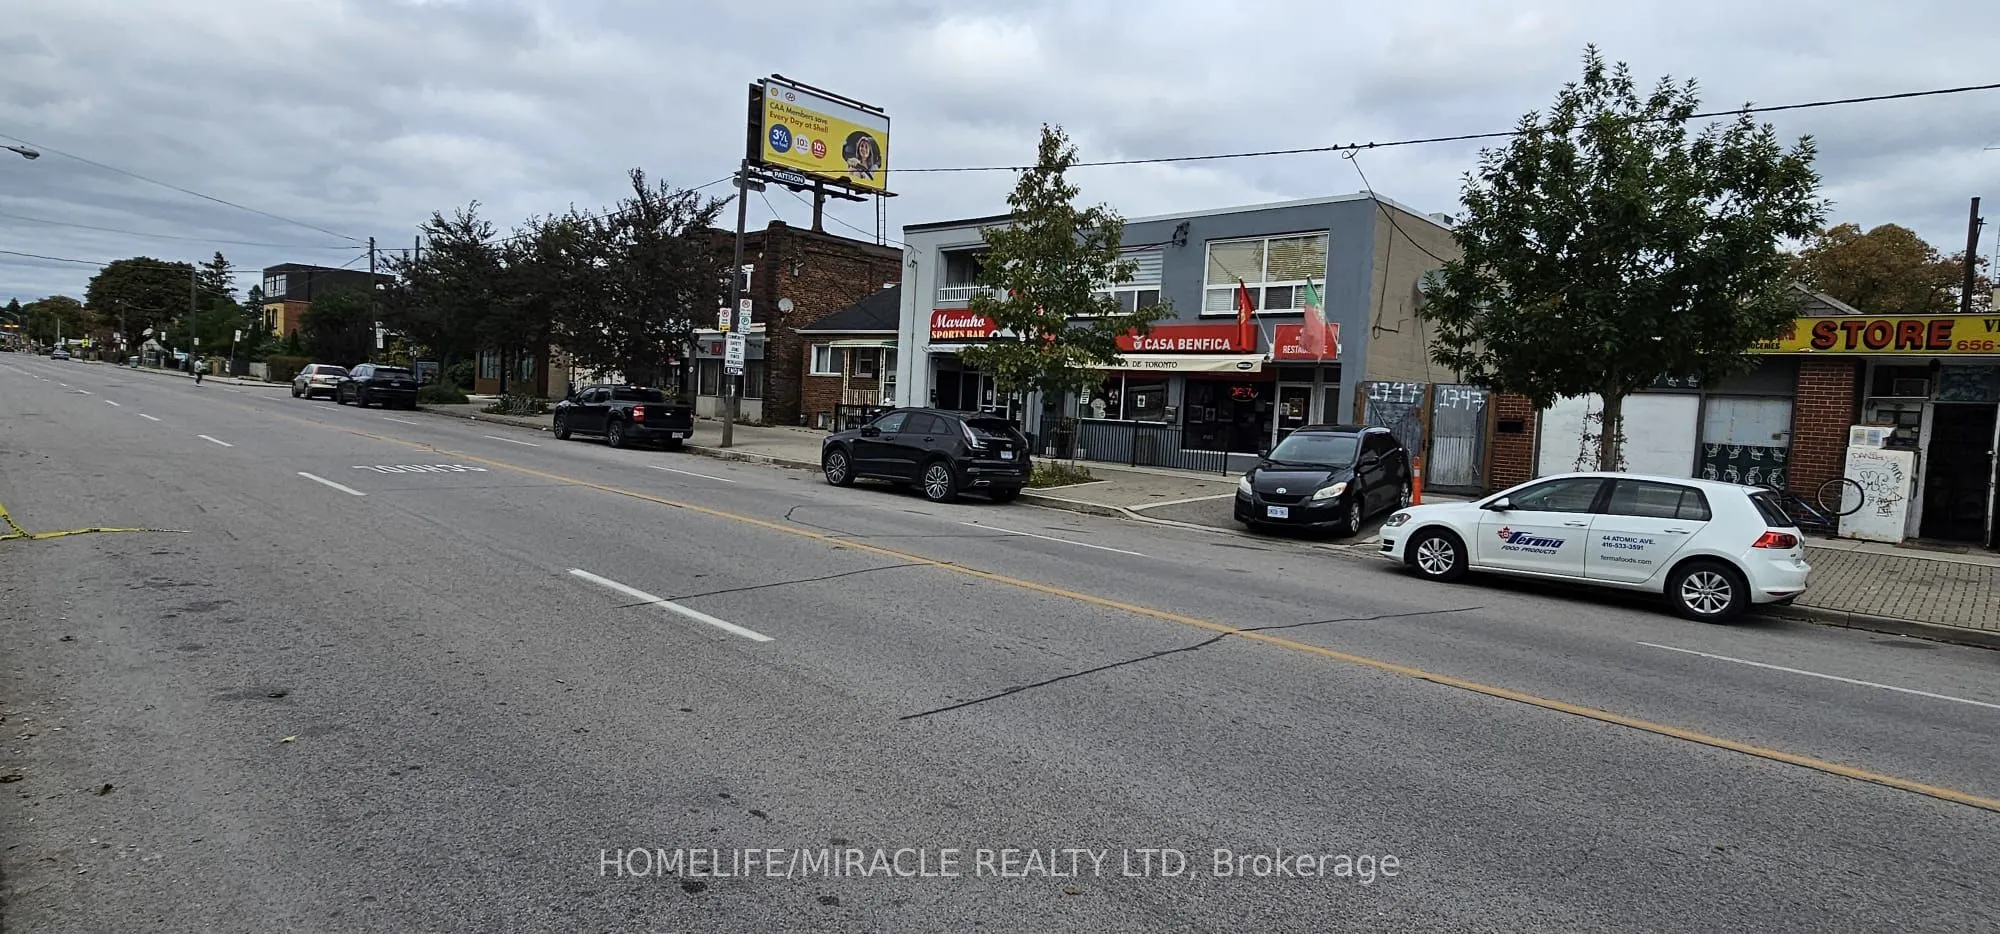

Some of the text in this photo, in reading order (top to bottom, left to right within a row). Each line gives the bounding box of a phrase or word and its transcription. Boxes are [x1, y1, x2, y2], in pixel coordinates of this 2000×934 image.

[769, 102, 785, 112] CAA
[786, 106, 814, 121] Members
[769, 111, 788, 123] Every
[790, 117, 804, 127] Day
[813, 124, 829, 133] Shell
[774, 171, 804, 184] PATTISON
[932, 314, 986, 328] Marinho
[931, 330, 965, 339] SPORTS
[966, 329, 985, 338] BAR
[1810, 320, 1956, 350] STORE
[1144, 338, 1231, 350] CASA BENFICA
[1144, 361, 1178, 369] TORONTO
[1369, 382, 1425, 403] 1747
[1439, 389, 1486, 410] 1747
[351, 463, 489, 474] SCHOOL
[1520, 546, 1557, 555] PRODUCTS
[1601, 542, 1644, 551] 416-533-3591
[1600, 554, 1653, 565] fermafoods.com
